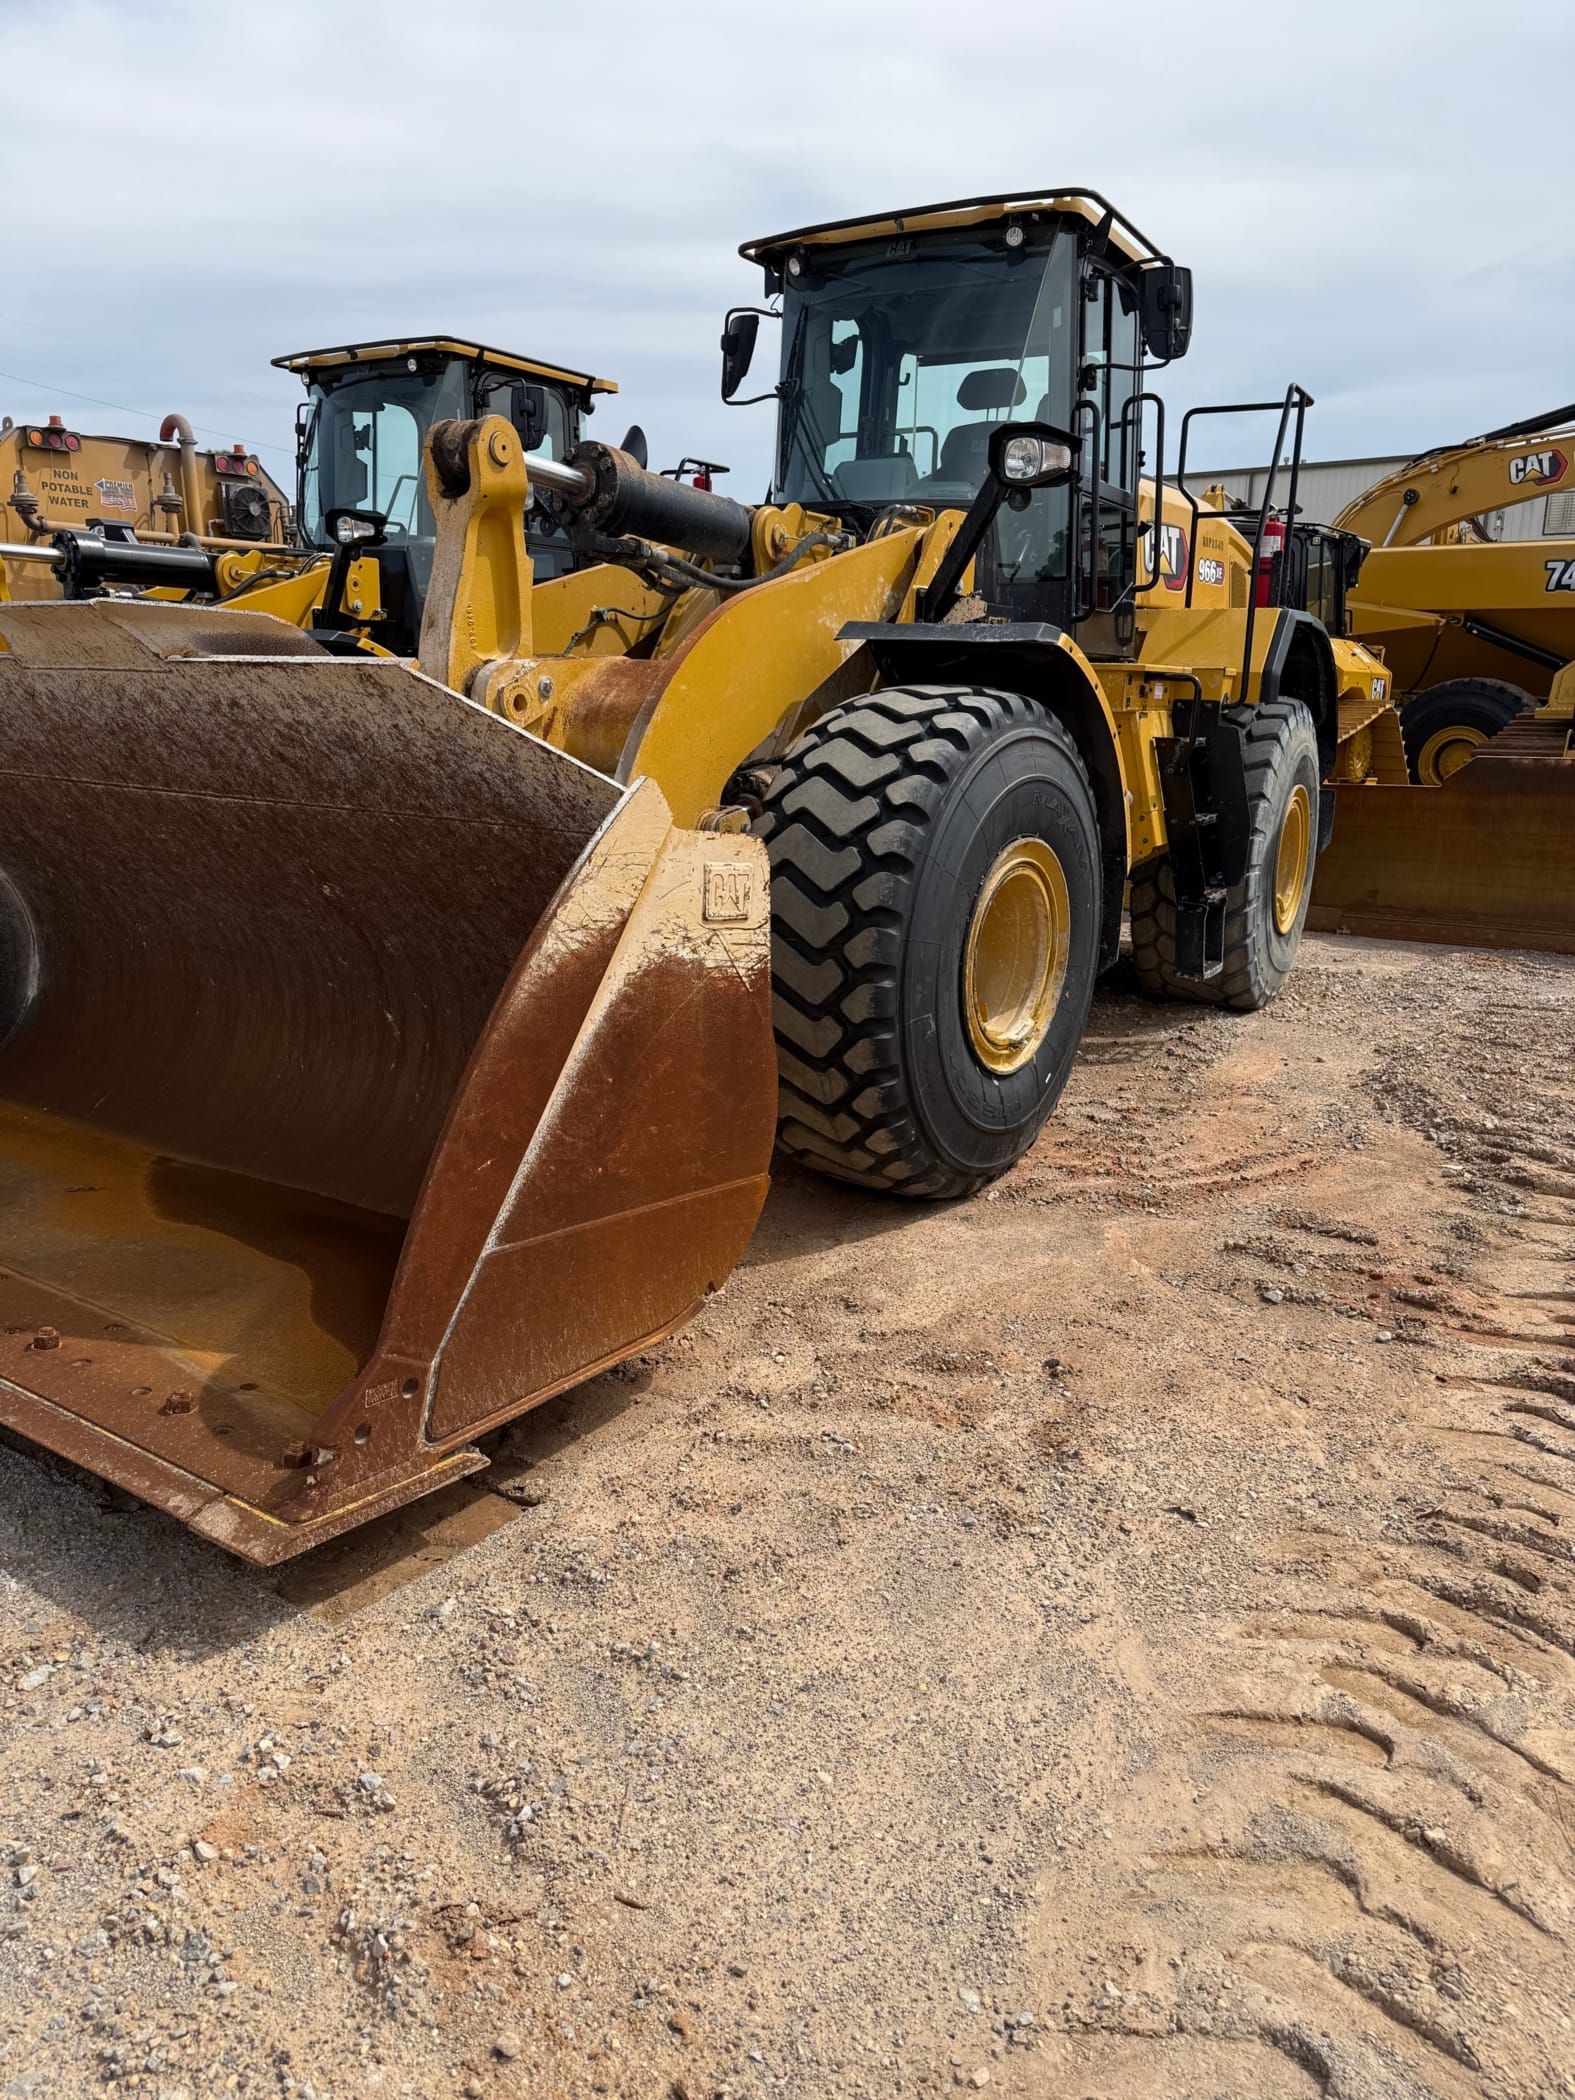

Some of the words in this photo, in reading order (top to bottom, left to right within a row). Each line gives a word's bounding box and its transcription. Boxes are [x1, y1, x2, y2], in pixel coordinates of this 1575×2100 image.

[53, 470, 79, 480] NON
[1510, 451, 1553, 485] CAT
[41, 481, 93, 496] POTABLE
[49, 495, 89, 508] WATER
[1144, 523, 1180, 576] CAT
[1371, 678, 1385, 701] CAT
[711, 873, 750, 912] CAT
